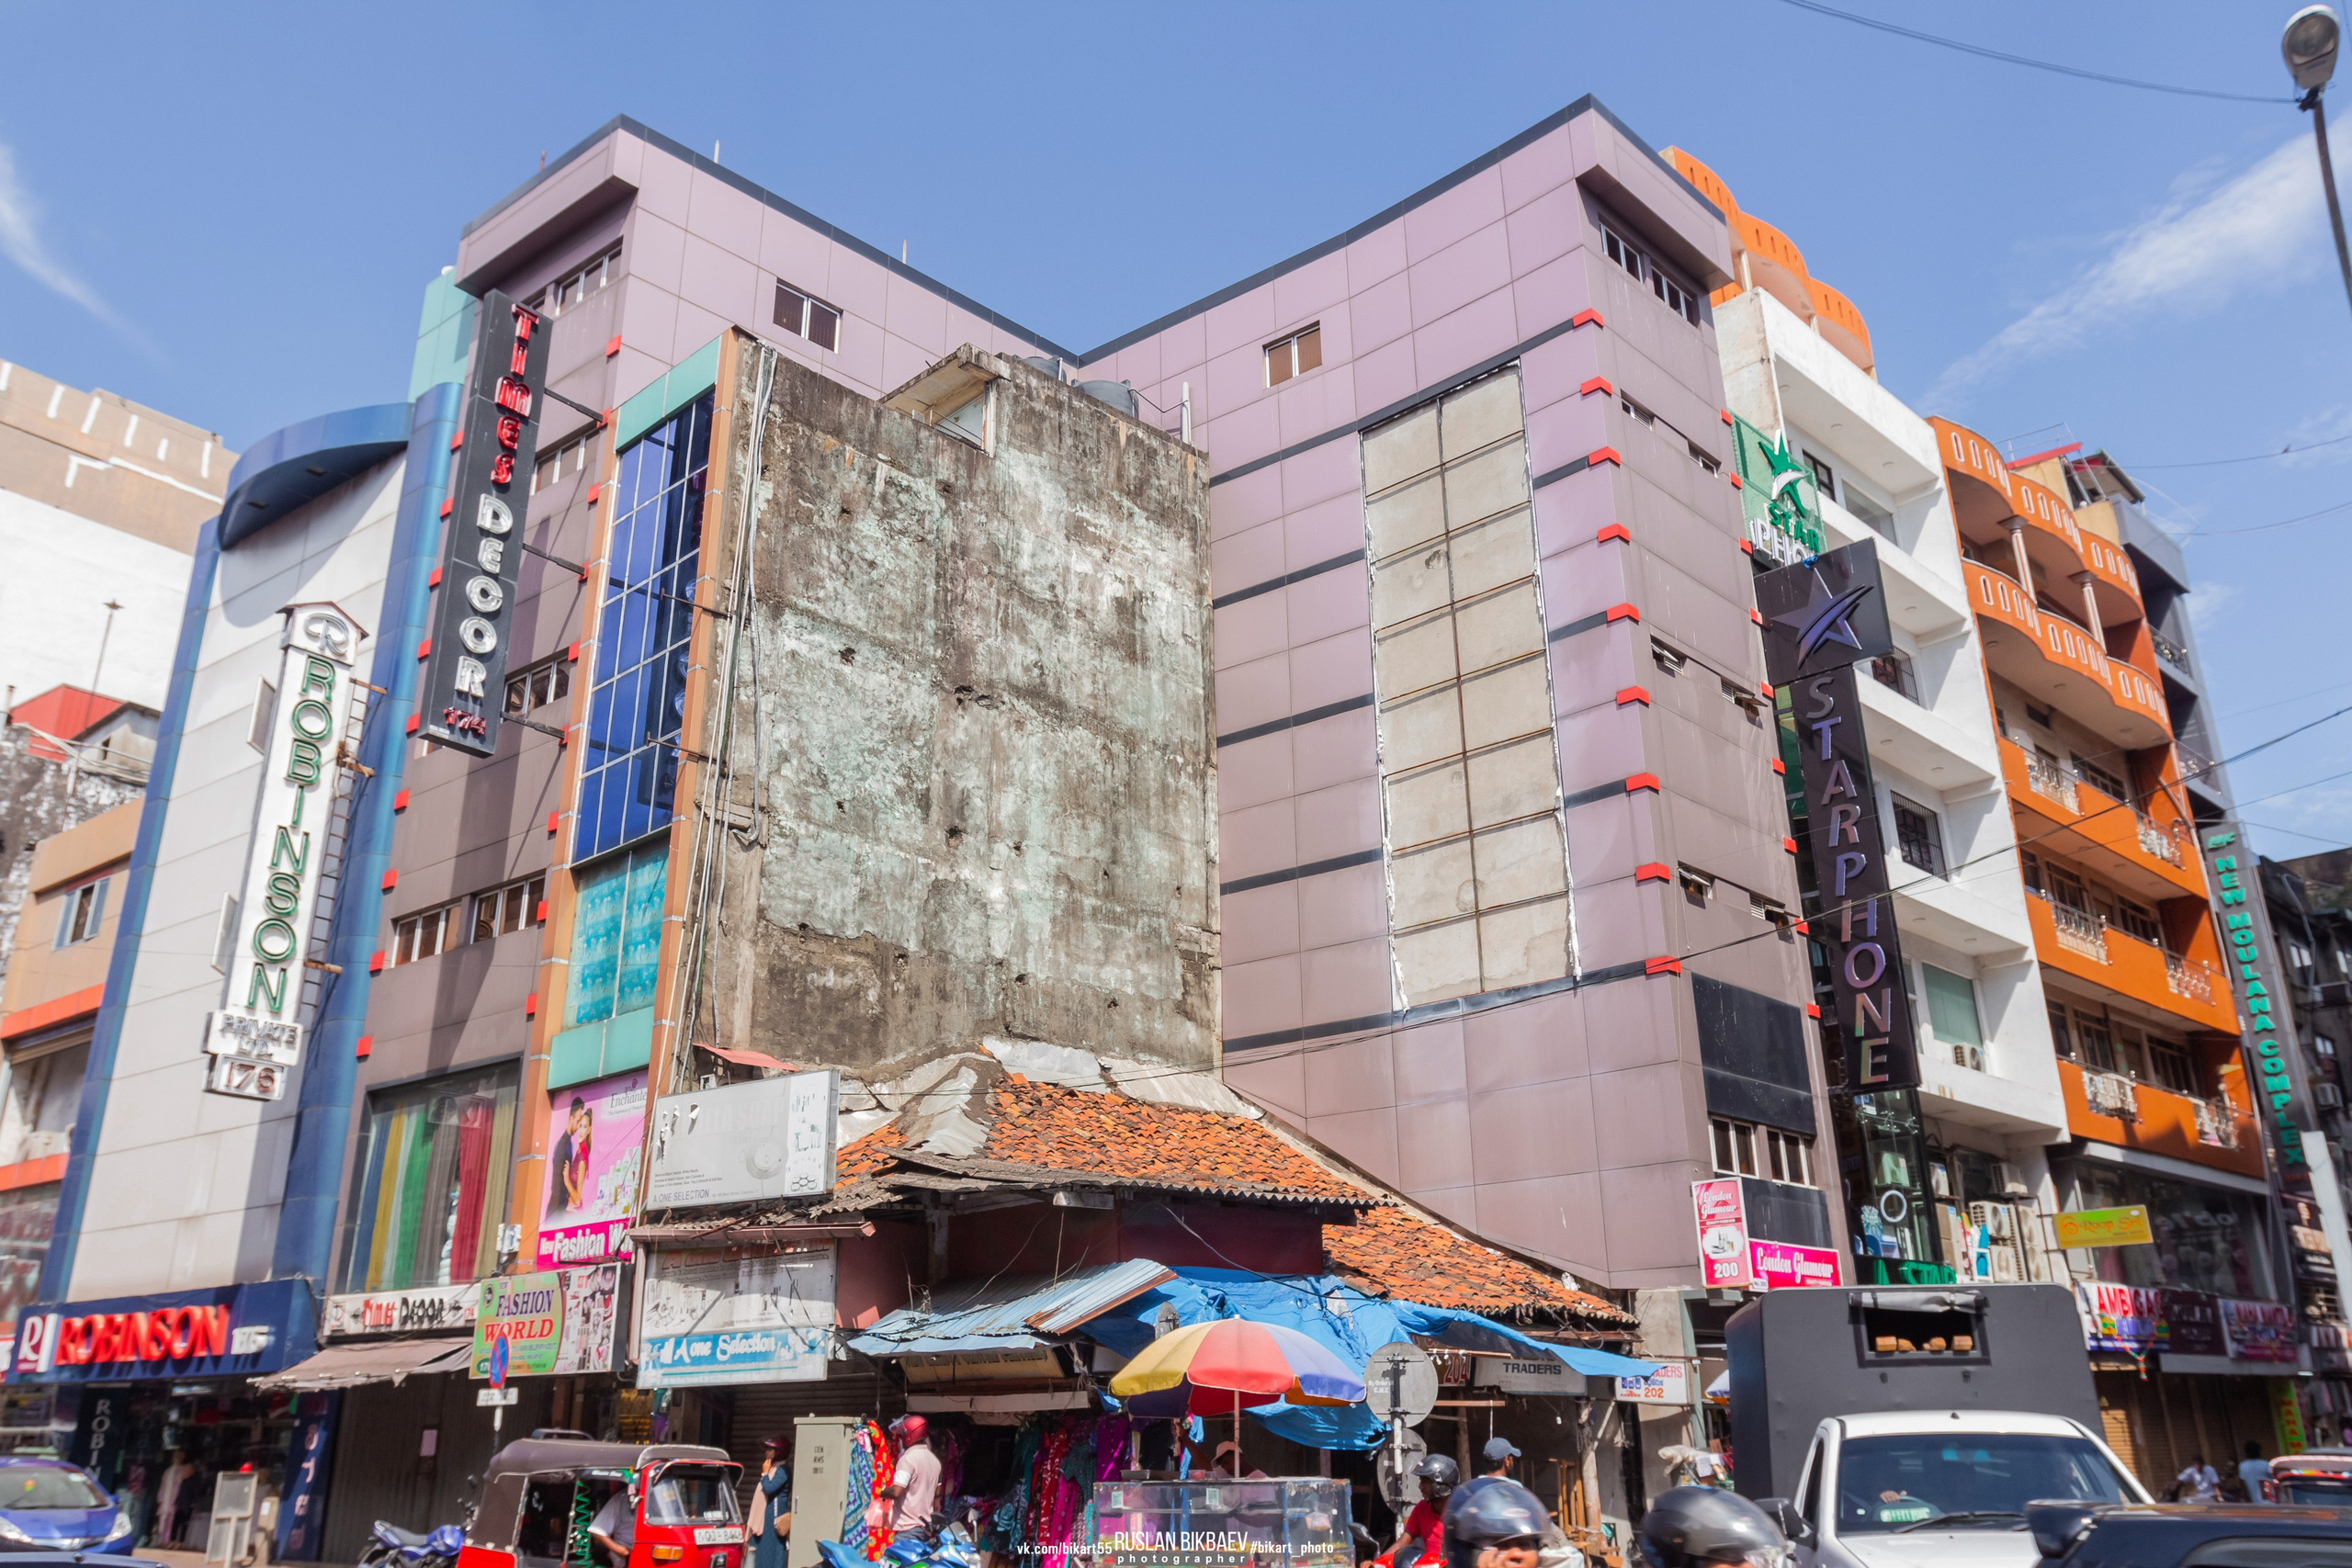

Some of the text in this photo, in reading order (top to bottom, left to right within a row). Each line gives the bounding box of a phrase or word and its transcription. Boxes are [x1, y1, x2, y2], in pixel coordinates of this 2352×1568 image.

[1750, 517, 1808, 567] PHO
[1769, 502, 1820, 553] STAR
[455, 492, 514, 698] DECOR
[444, 706, 487, 735] 174
[245, 654, 336, 1013] ROBINSON
[1806, 676, 1892, 1085] STARPHONE
[2215, 855, 2246, 905] NEW
[2226, 912, 2276, 1032] MOULANA
[222, 1014, 298, 1044] PRIVATE
[227, 1062, 276, 1093] 176
[2258, 1040, 2305, 1165] COMPLEX
[653, 1194, 658, 1203] A
[659, 1193, 673, 1202] ONE
[673, 1189, 710, 1201] SELECTION
[1702, 1203, 1736, 1219] Glamour
[1703, 1190, 1732, 1202] London
[539, 1237, 555, 1256] New
[553, 1228, 605, 1263] Fashion
[1713, 1262, 1739, 1279] 200
[1757, 1247, 1834, 1284] London Glamour
[495, 1289, 554, 1317] FASHION
[53, 1304, 232, 1365] ROBINSON
[484, 1318, 554, 1342] WORLD
[690, 1340, 712, 1358] one
[716, 1332, 776, 1361] Selection
[1503, 1362, 1562, 1375] TRADERS
[1653, 1365, 1683, 1379] ADERS
[1644, 1387, 1664, 1399] 202
